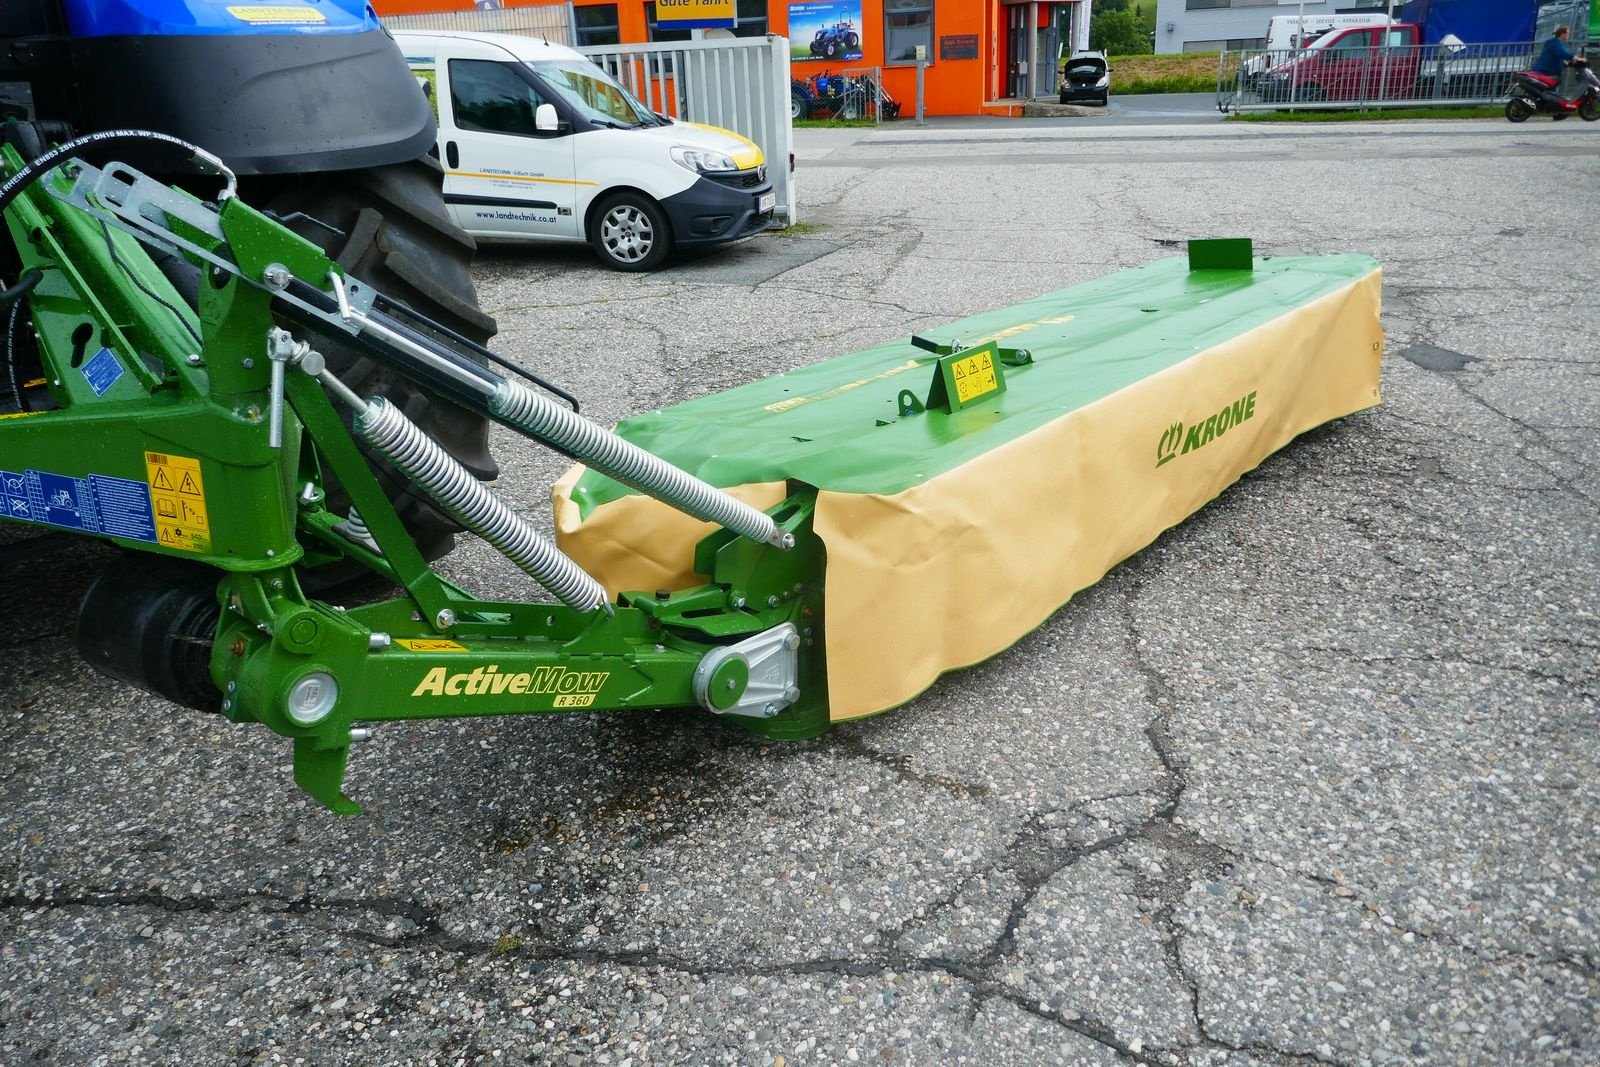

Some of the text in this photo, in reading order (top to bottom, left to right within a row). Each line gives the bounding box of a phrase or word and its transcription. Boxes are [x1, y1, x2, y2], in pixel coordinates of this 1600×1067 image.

[3, 166, 32, 191] RHEINE
[34, 150, 59, 166] EN853
[59, 142, 76, 152] 2SN
[93, 132, 115, 140] DN10
[476, 211, 557, 223] www.landtechnik.co.at
[1180, 390, 1257, 455] KRONE
[411, 665, 610, 697] ActiveMow
[558, 696, 590, 706] R 360
